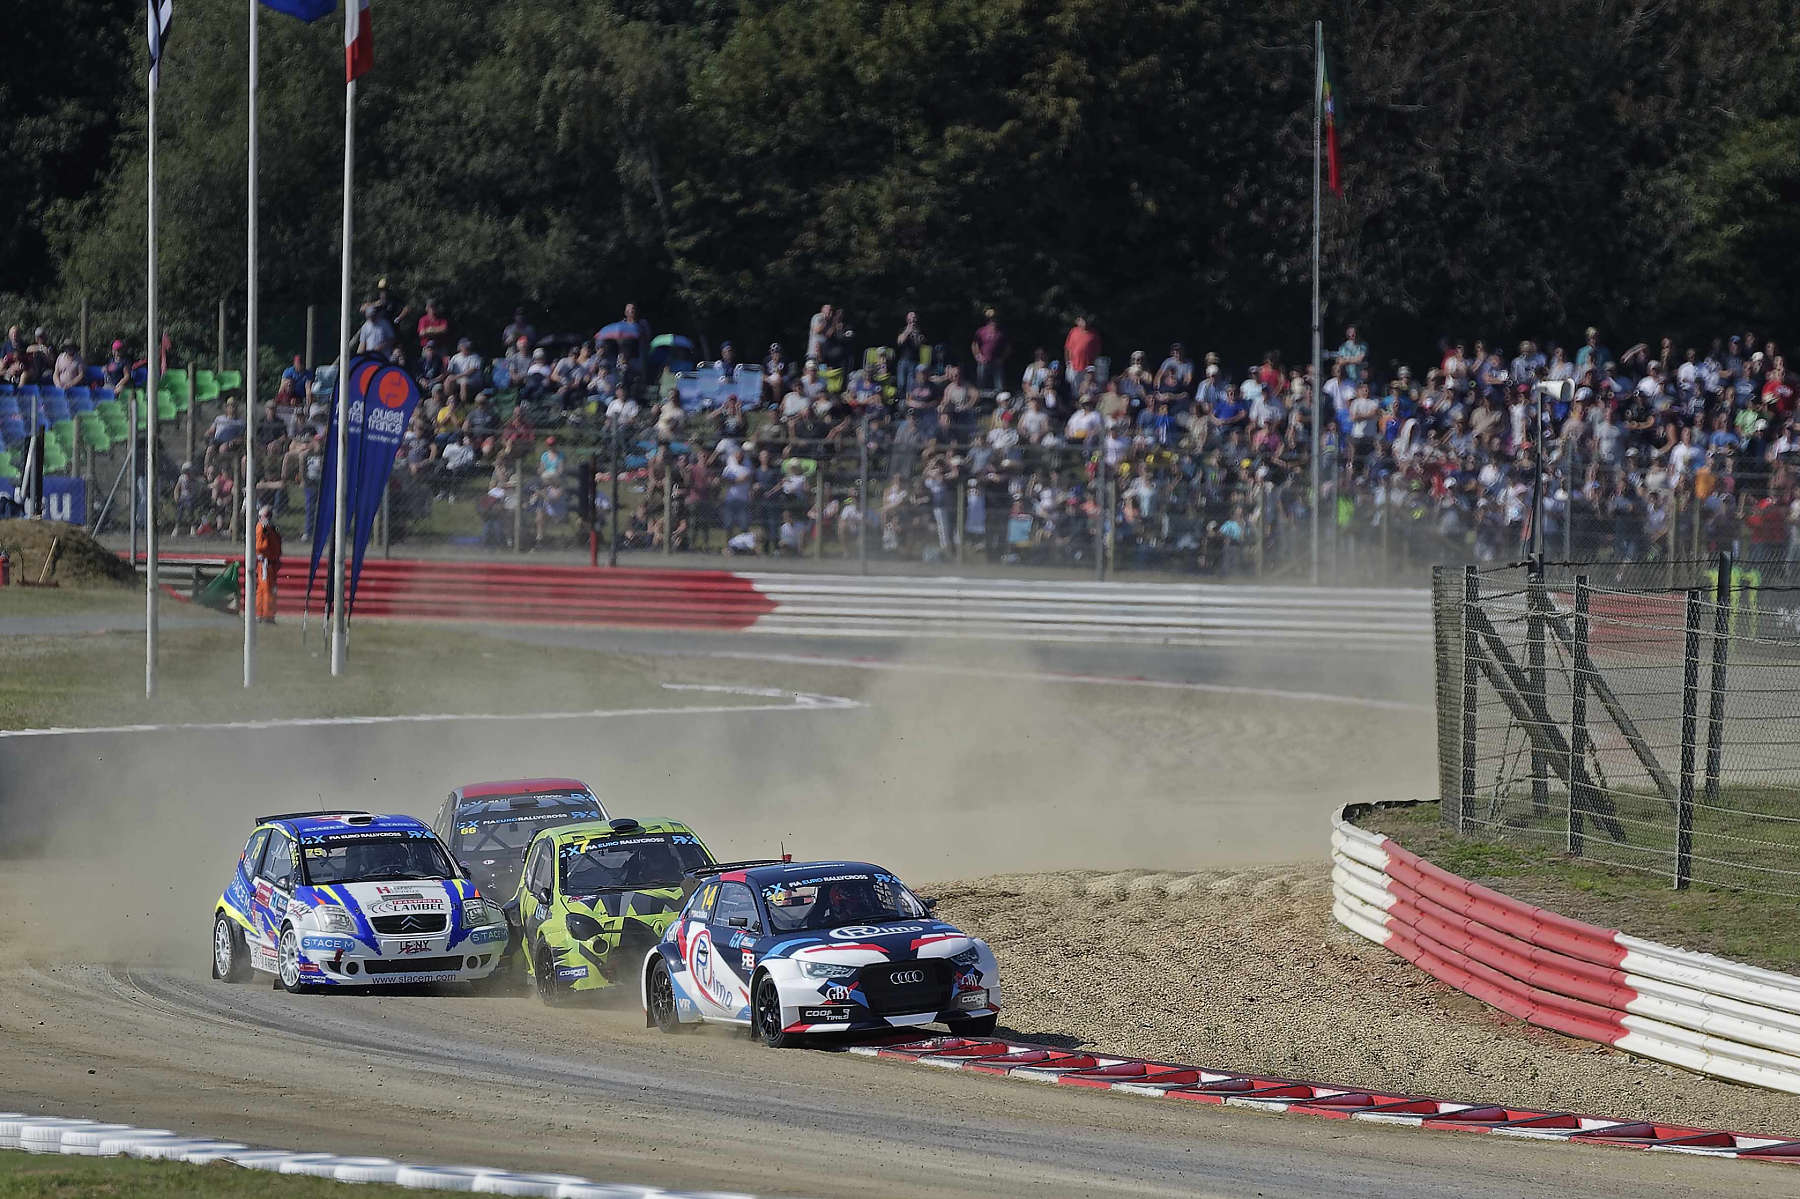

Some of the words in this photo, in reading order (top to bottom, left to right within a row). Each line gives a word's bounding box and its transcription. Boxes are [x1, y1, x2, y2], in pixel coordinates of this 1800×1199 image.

[372, 408, 404, 422] ouest
[368, 415, 402, 434] france
[517, 813, 568, 822] RALLYCROSS
[460, 827, 477, 835] 66
[573, 839, 591, 855] 7
[598, 840, 619, 849] EURO
[619, 836, 665, 845] RALLYCROSS
[789, 880, 802, 888] FIA
[802, 877, 823, 885] EURO
[823, 873, 869, 882] RALLYCROSS
[701, 884, 718, 911] 14
[371, 973, 457, 985] www.stacem.com
[961, 973, 981, 987] GBY
[825, 985, 853, 1001] GBY
